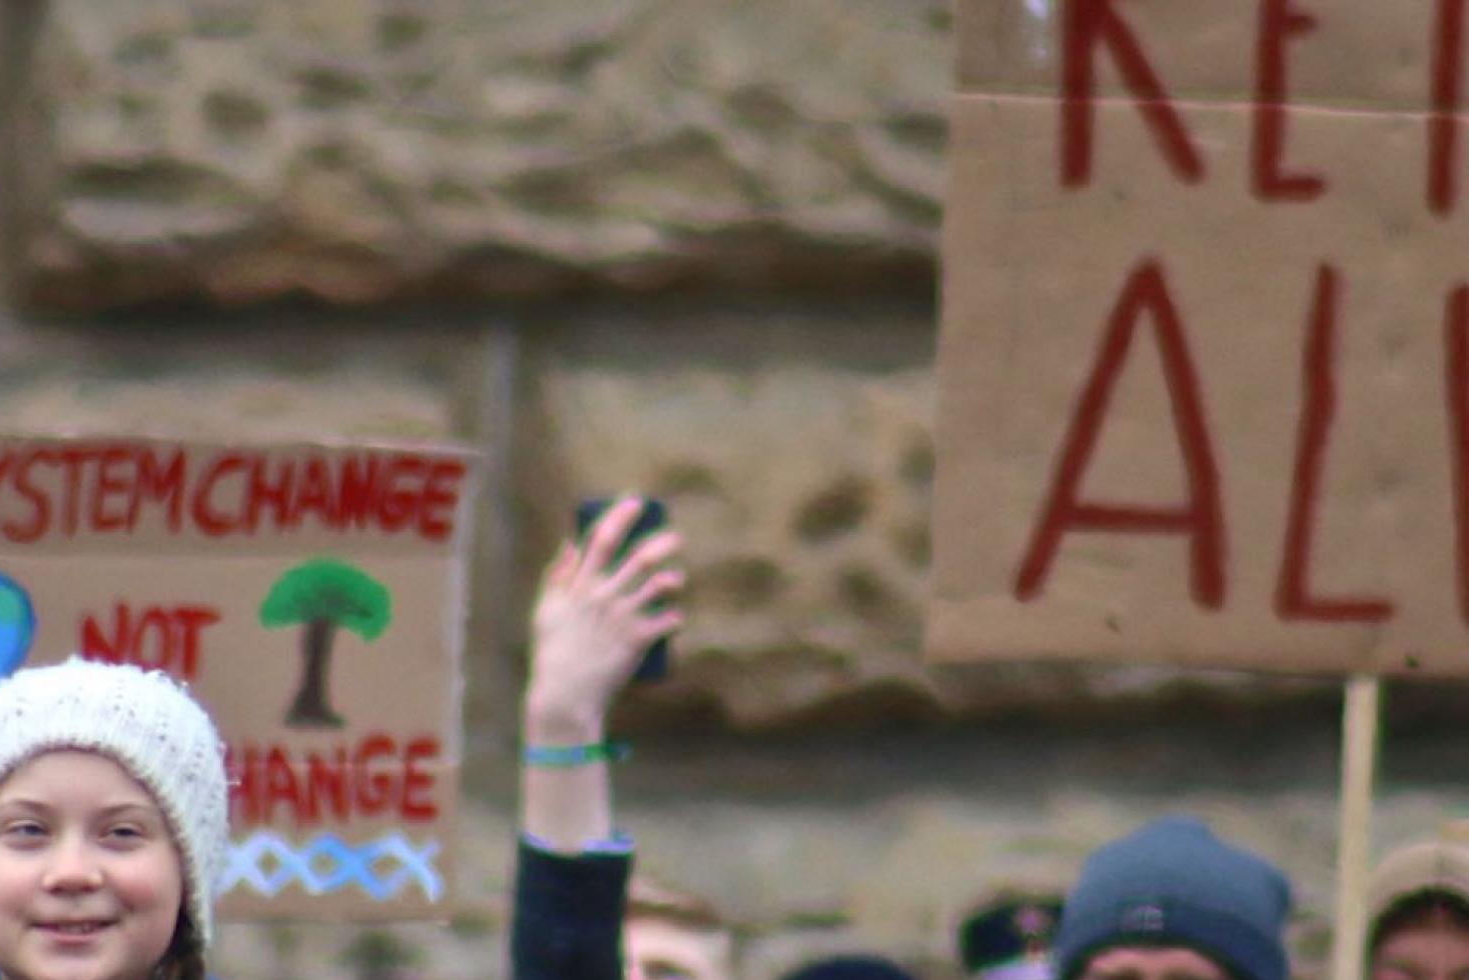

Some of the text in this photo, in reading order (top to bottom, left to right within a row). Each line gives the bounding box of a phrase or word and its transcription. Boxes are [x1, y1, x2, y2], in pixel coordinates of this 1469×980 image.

[191, 453, 466, 542] CHANGE
[79, 601, 222, 681] NOT
[225, 729, 439, 828] HANGE
